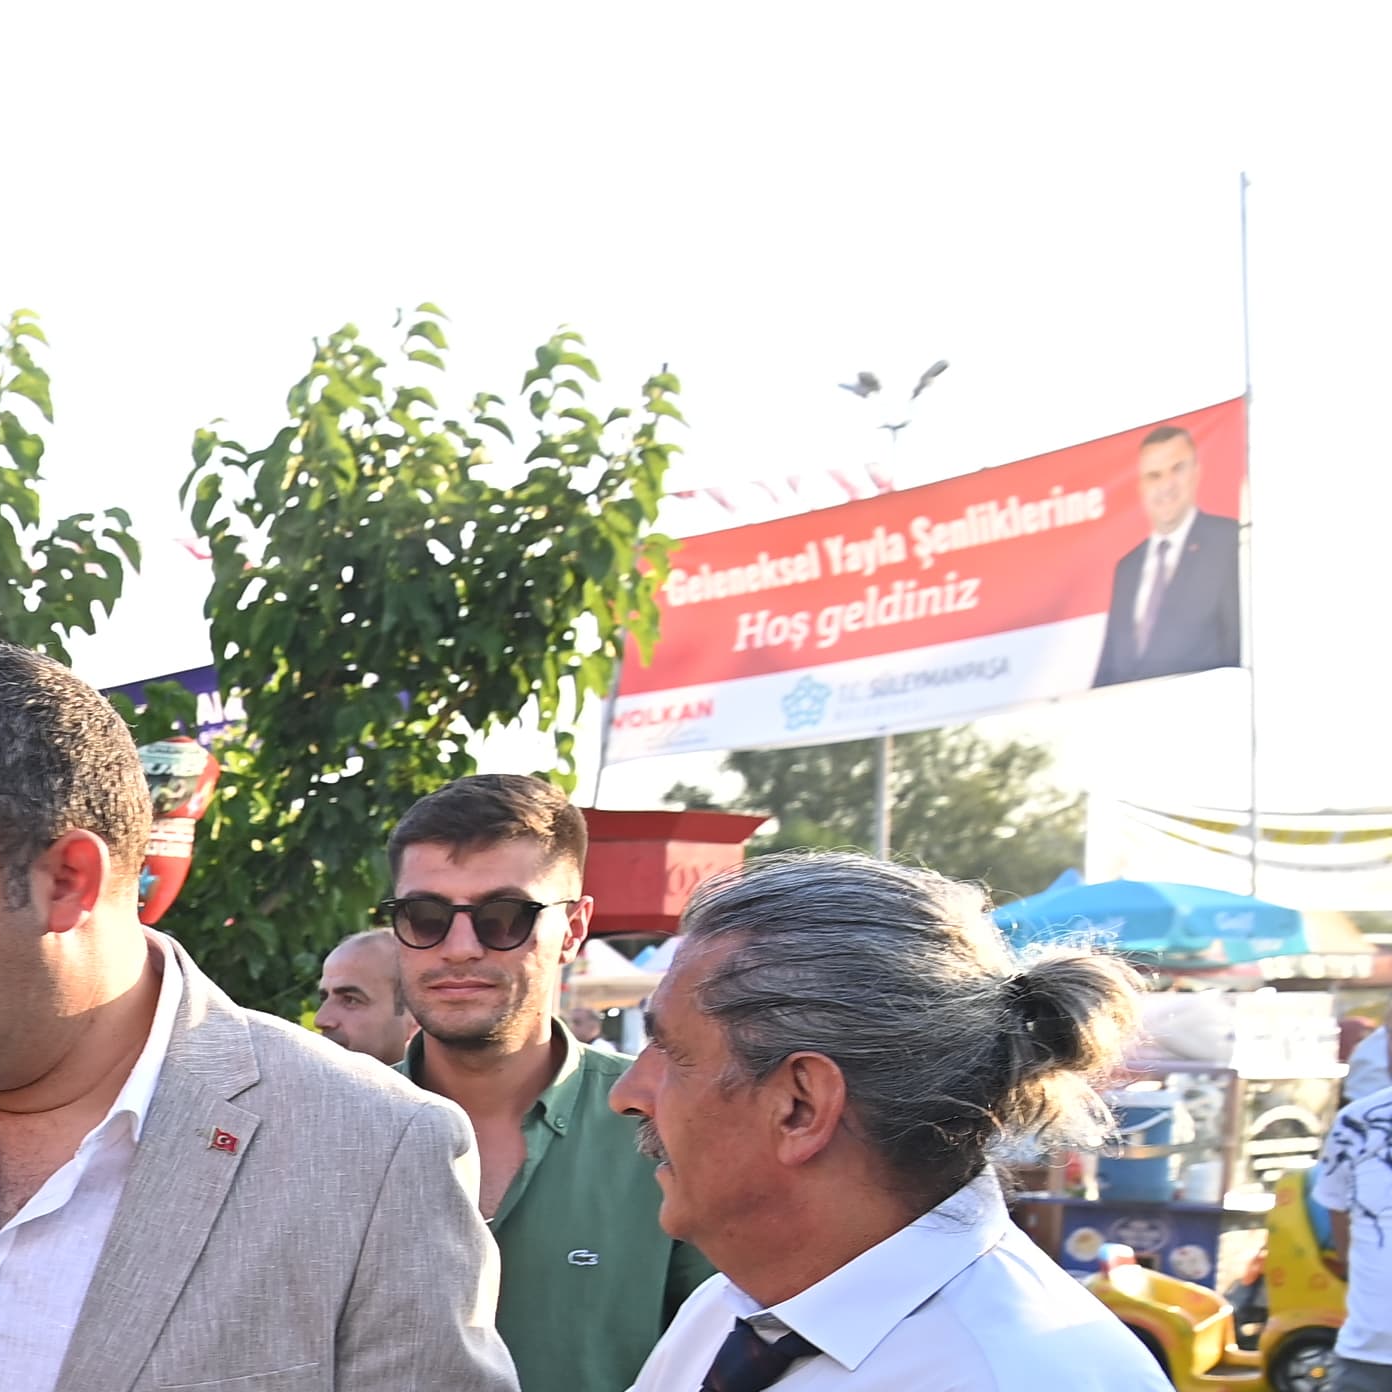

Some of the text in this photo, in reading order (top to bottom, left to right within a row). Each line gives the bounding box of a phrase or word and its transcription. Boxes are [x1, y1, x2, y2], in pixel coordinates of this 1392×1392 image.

[666, 485, 1105, 607] Geleneksel Yayla Şenliklerine
[733, 571, 982, 652] Hoş geldiniz
[612, 698, 715, 731] VOLKAN
